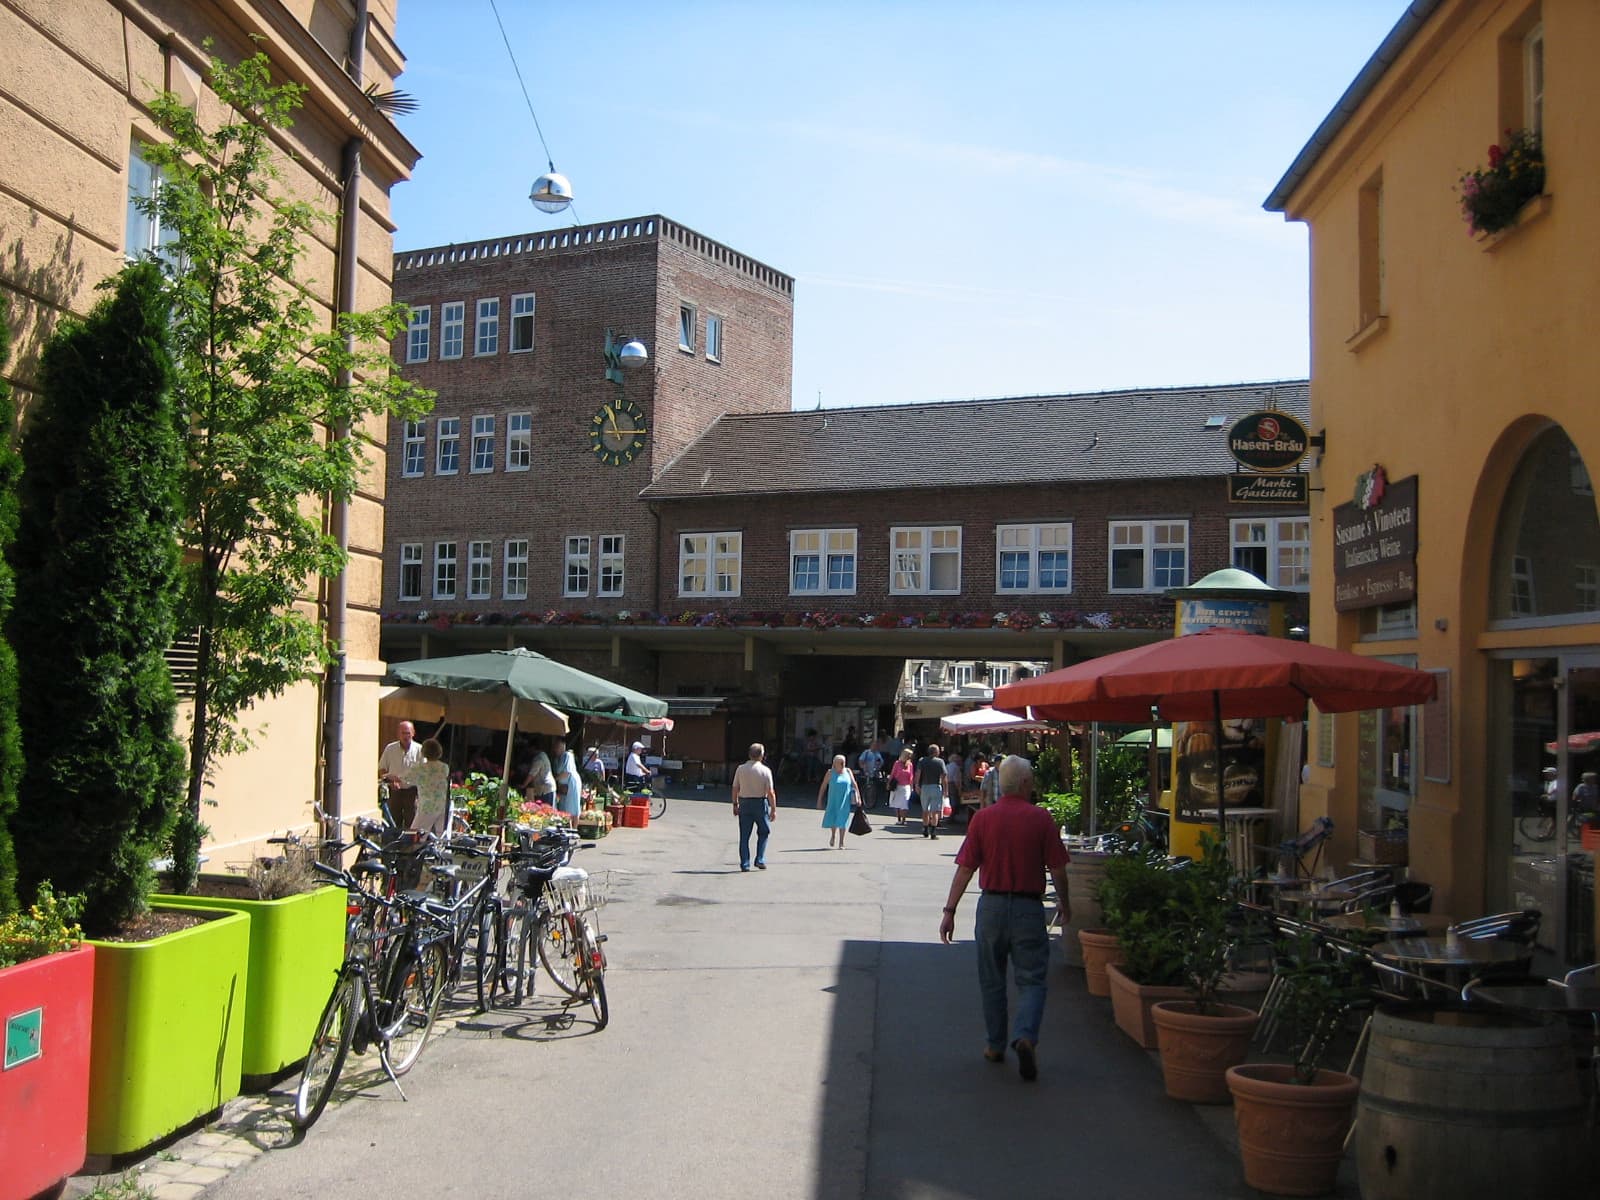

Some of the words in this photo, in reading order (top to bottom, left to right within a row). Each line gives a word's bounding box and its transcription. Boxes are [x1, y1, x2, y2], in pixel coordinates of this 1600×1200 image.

[1232, 439, 1304, 452] Hasen-Bräu
[1250, 477, 1297, 489] Markt-
[1235, 486, 1298, 500] Gaststätte
[1335, 514, 1372, 546] Susanne's
[1373, 505, 1411, 533] Vinoteca
[1379, 536, 1401, 559] Weine
